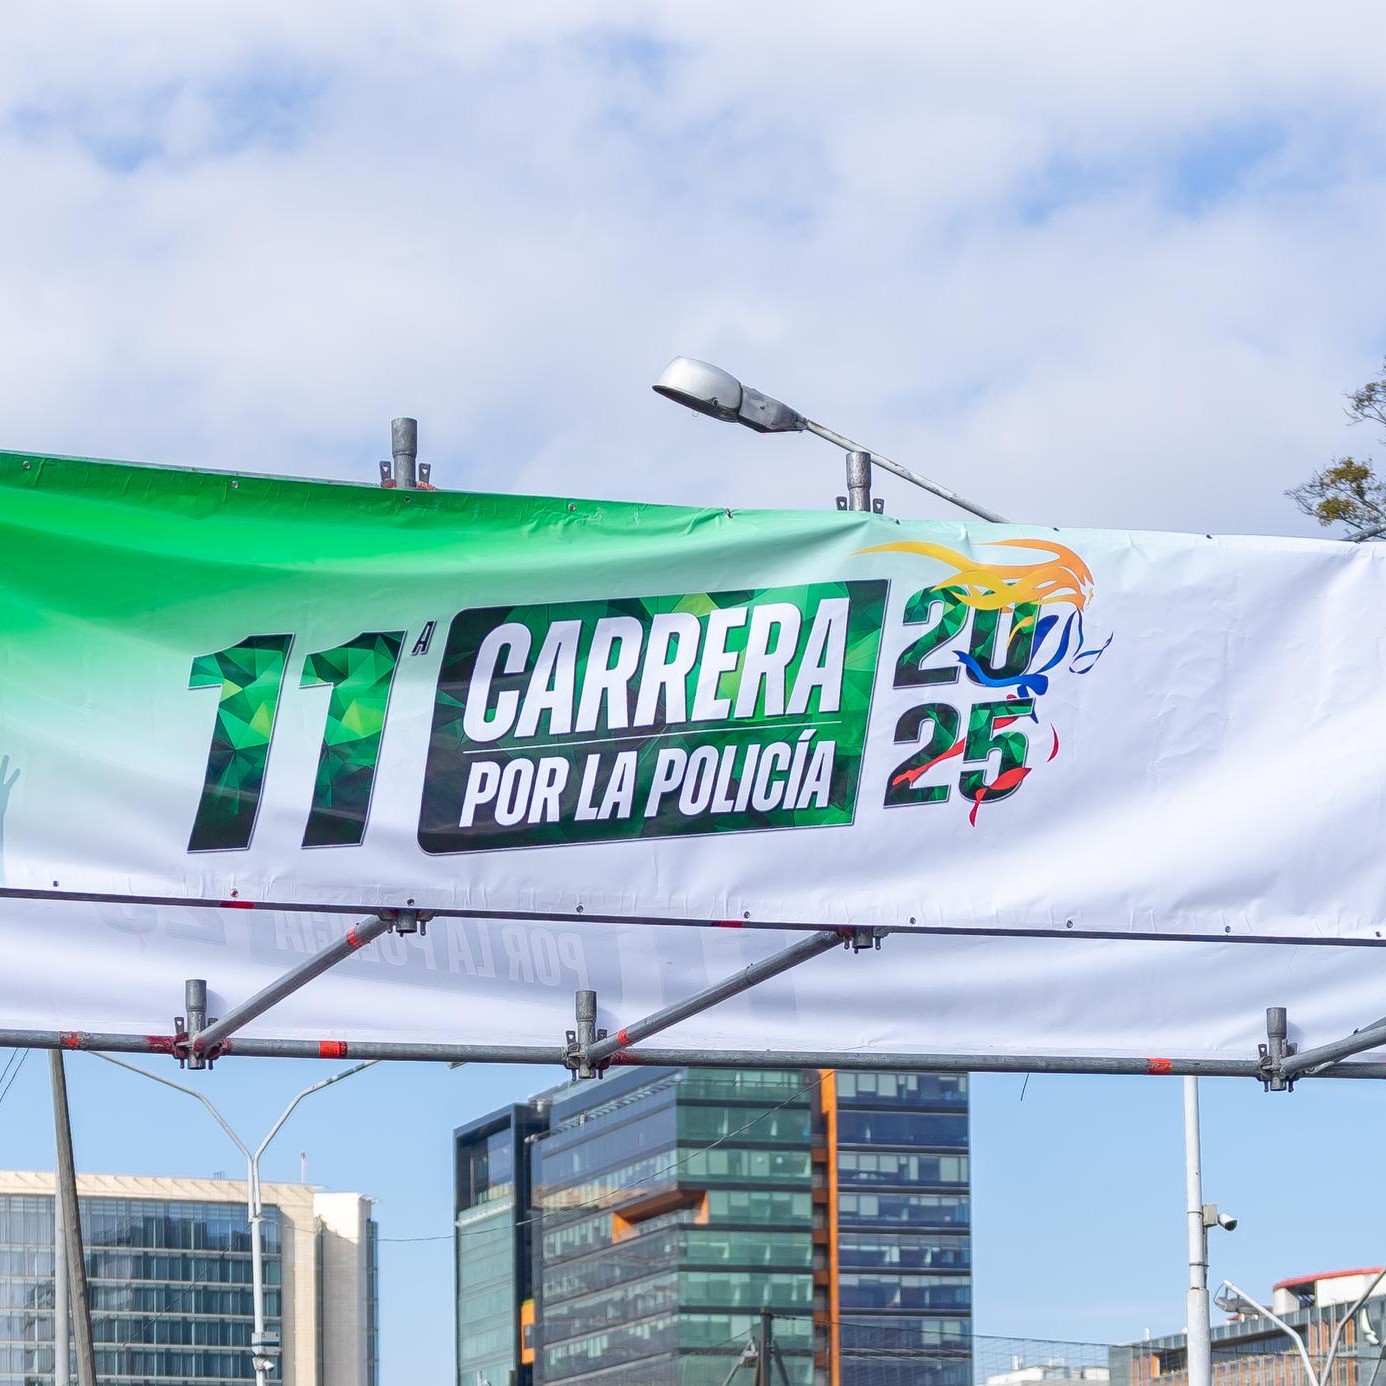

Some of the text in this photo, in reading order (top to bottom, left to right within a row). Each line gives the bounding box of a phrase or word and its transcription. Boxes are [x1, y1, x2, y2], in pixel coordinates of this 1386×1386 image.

[464, 596, 851, 743] CARRERA
[460, 728, 835, 828] POR LA POLICÍA
